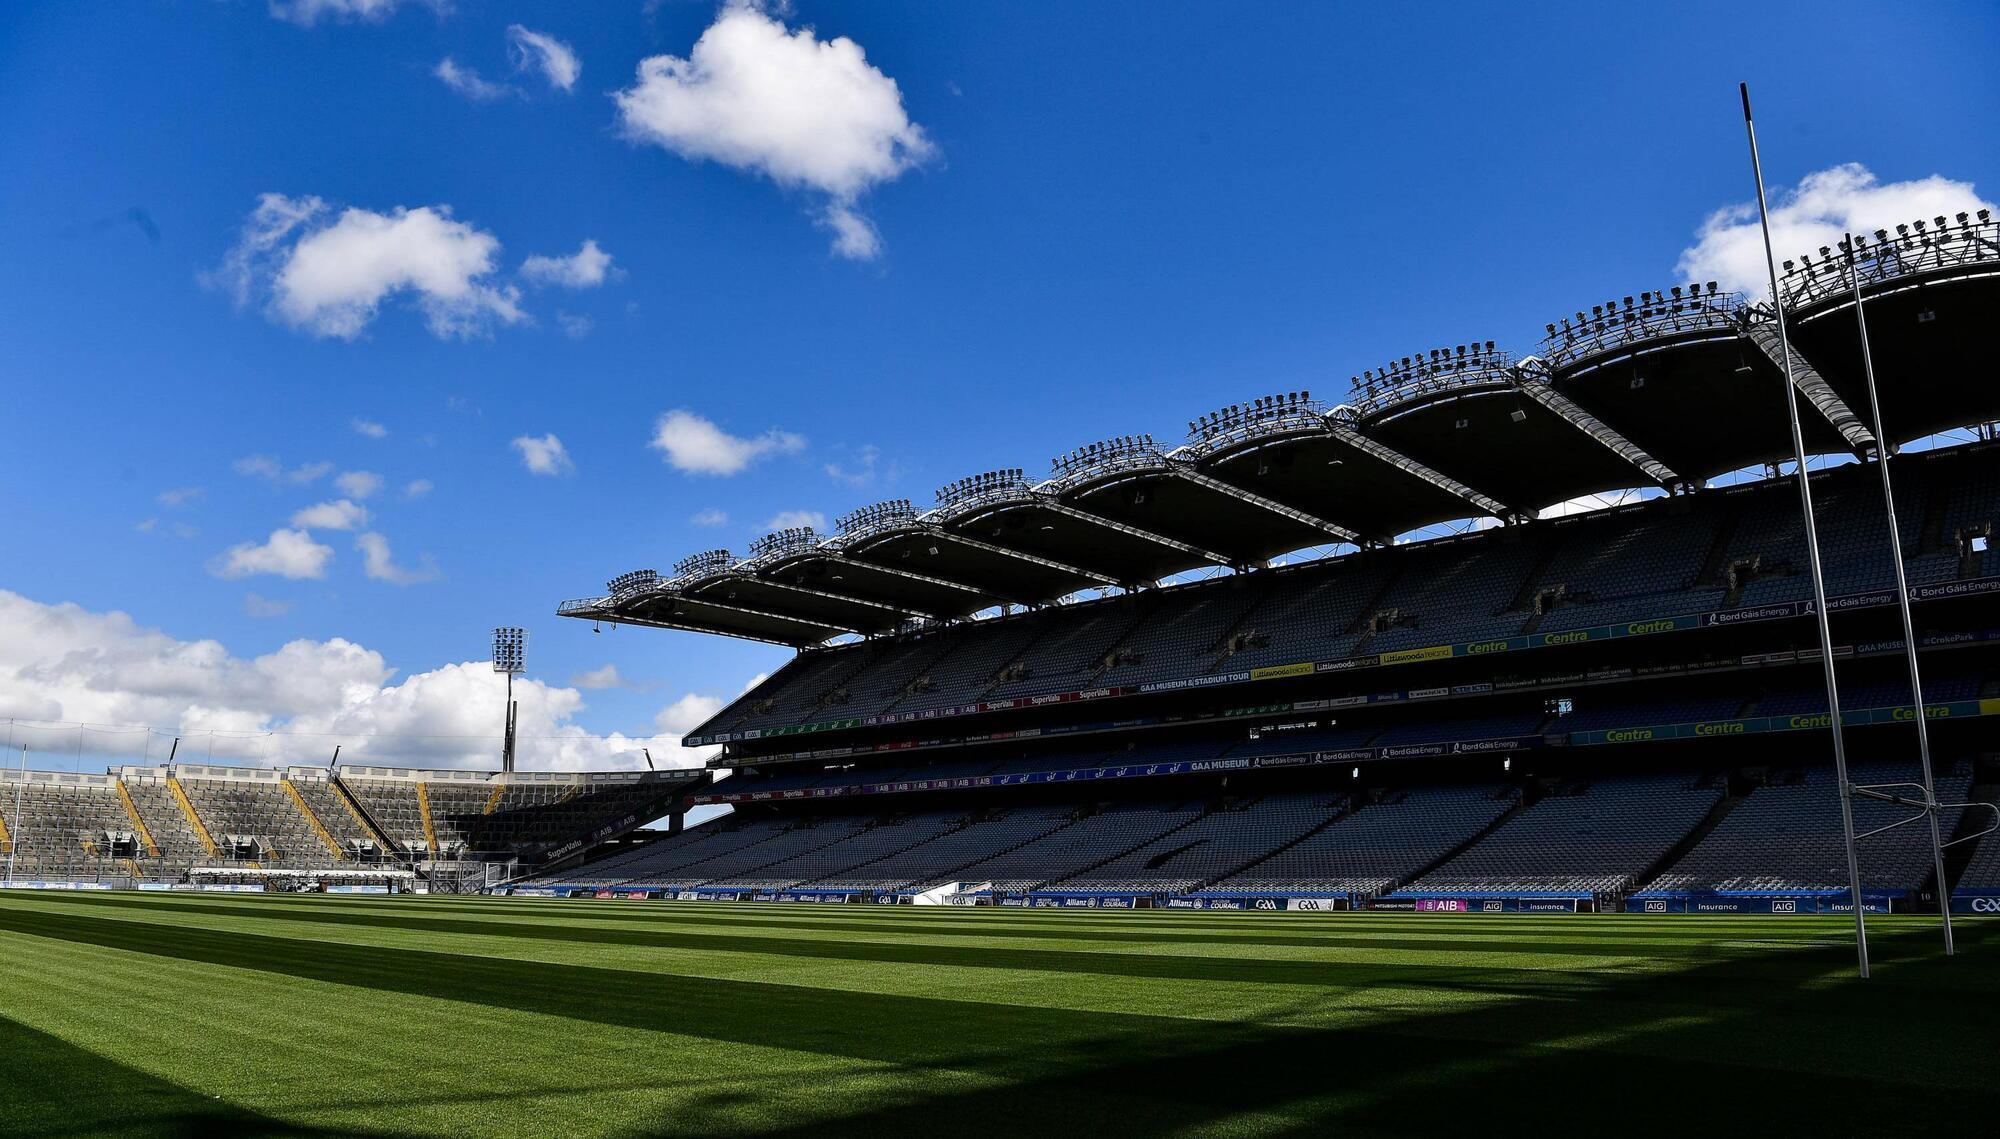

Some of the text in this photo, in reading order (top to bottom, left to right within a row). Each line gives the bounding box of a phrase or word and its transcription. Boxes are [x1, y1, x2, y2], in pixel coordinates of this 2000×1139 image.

[1921, 586, 1945, 597] Bord
[1947, 583, 1967, 594] Gáis
[1840, 597, 1859, 607] Gáis
[1860, 594, 1892, 606] Energy
[1720, 607, 1790, 623] Bord Gáis Energy
[1627, 620, 1675, 635] Centra
[1544, 630, 1589, 645] Centra
[1466, 641, 1508, 655] Centra
[1858, 644, 1876, 653] GAA
[1877, 640, 1908, 652] MUSEU
[1140, 672, 1249, 693] GAA MUSEUM & STADIUM TOUR
[1079, 689, 1110, 699] SuperValu
[1031, 695, 1061, 705] SuperValu
[966, 705, 976, 713] AIB
[986, 701, 1015, 710] SuperValu
[905, 713, 915, 721] AIB
[925, 710, 935, 719] AIB
[946, 708, 955, 716] AIB
[1790, 714, 1842, 729] Centr
[1694, 722, 1744, 736] Centra
[1606, 729, 1653, 742] Centra
[1461, 739, 1518, 752] Bord Gáis Energy
[1323, 750, 1372, 761] Bord Gáis Energy
[1390, 745, 1442, 757] Bord Gáis Energy
[1191, 759, 1249, 771] GAA MUSEUM
[1275, 757, 1287, 765] Gáis
[1287, 756, 1307, 765] Energy
[918, 782, 928, 790] AIB
[938, 780, 948, 788] AIB
[959, 779, 969, 787] AIB
[980, 777, 990, 786] AIB
[880, 784, 889, 792] AIB
[899, 783, 908, 791] AIB
[600, 826, 613, 837] AIB
[547, 840, 582, 859] SuperValu
[878, 896, 891, 904] GAA
[1065, 898, 1087, 907] Allianz
[1168, 899, 1193, 908] Allianz
[1255, 900, 1277, 910] GAA
[1298, 900, 1320, 910] GAA
[1436, 900, 1458, 911] AIB
[1485, 902, 1500, 910] AIG
[1647, 902, 1664, 910] AIG
[1775, 902, 1793, 911] AIG
[1831, 903, 1876, 911] Insurnce
